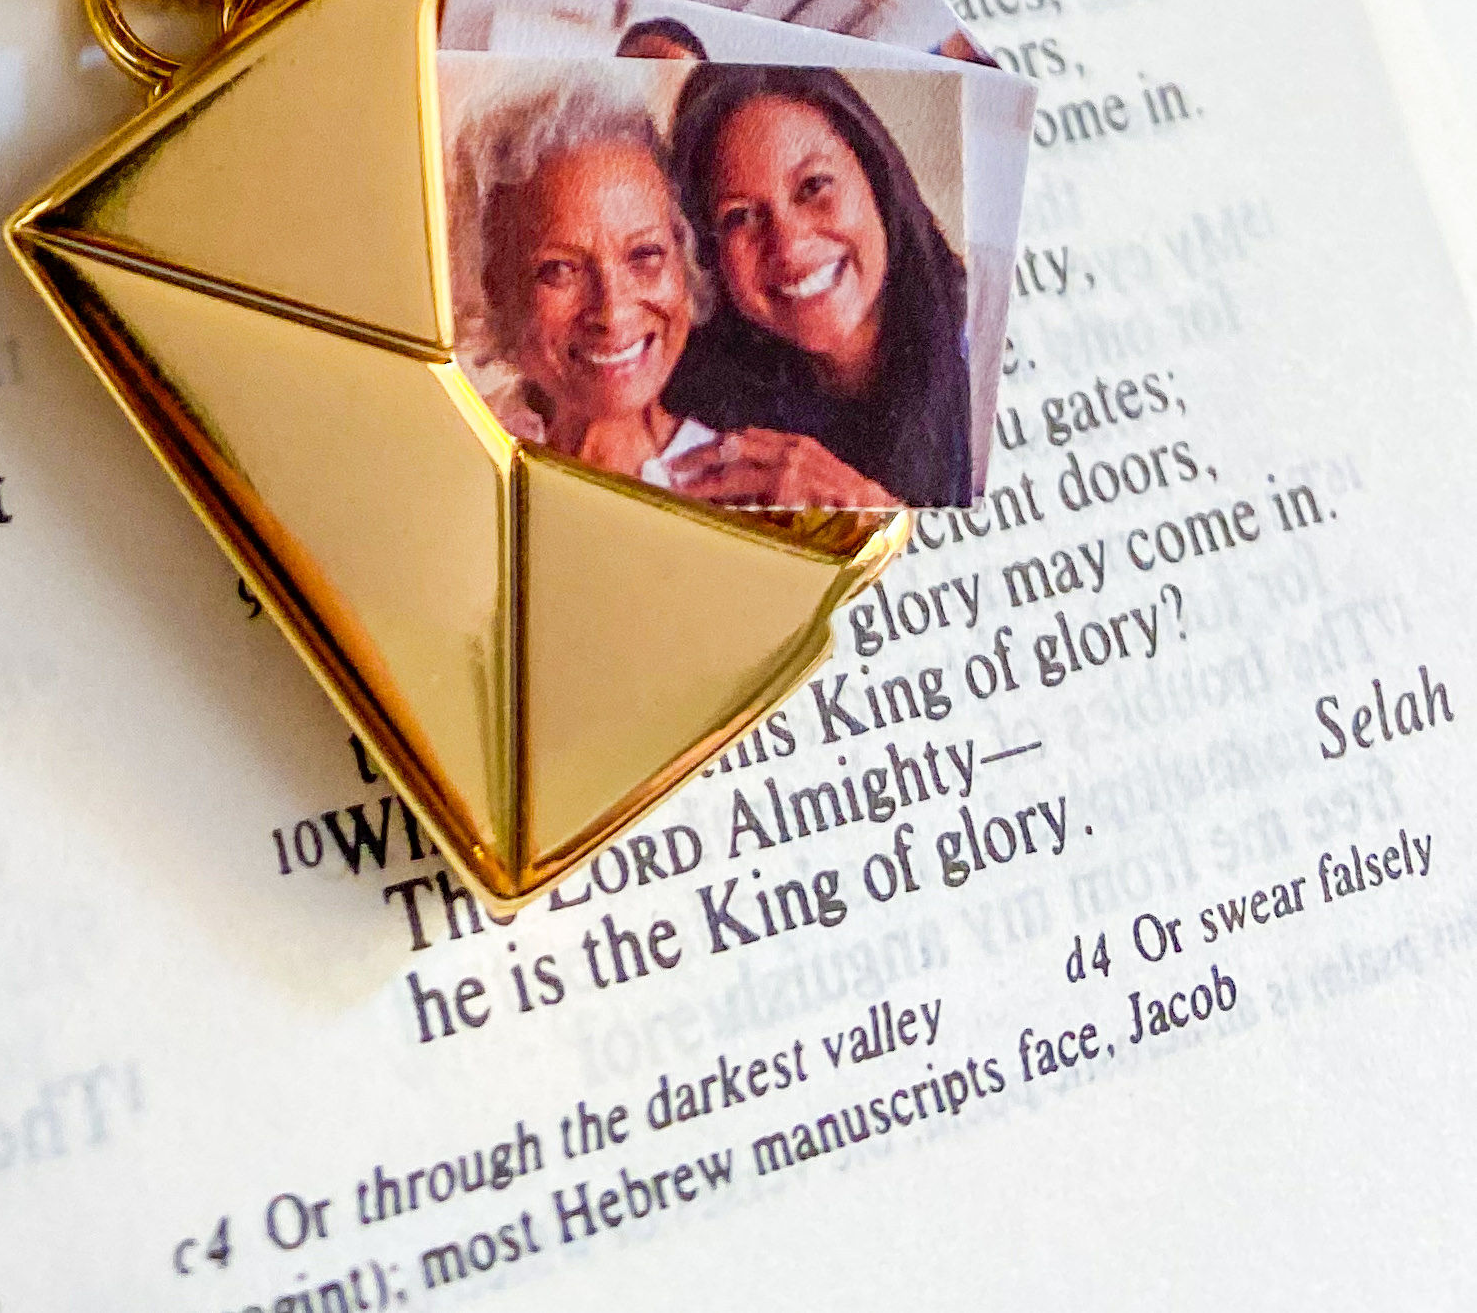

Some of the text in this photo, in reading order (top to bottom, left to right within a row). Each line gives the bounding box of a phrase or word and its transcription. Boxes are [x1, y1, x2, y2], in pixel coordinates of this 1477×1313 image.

[1060, 442, 1217, 511] doors,
[851, 475, 1337, 656] glory may come in.
[809, 583, 1187, 745] King of glory?
[1316, 666, 1453, 759] Selah
[407, 797, 1095, 1043] he is the King of glory.
[1133, 914, 1182, 962] Or
[1200, 878, 1306, 943] swear
[1319, 829, 1431, 902] falsely
[267, 999, 941, 1250] Or through the darkest valley
[422, 965, 1236, 1288] most Hebrew manuscripts face, Jacob
